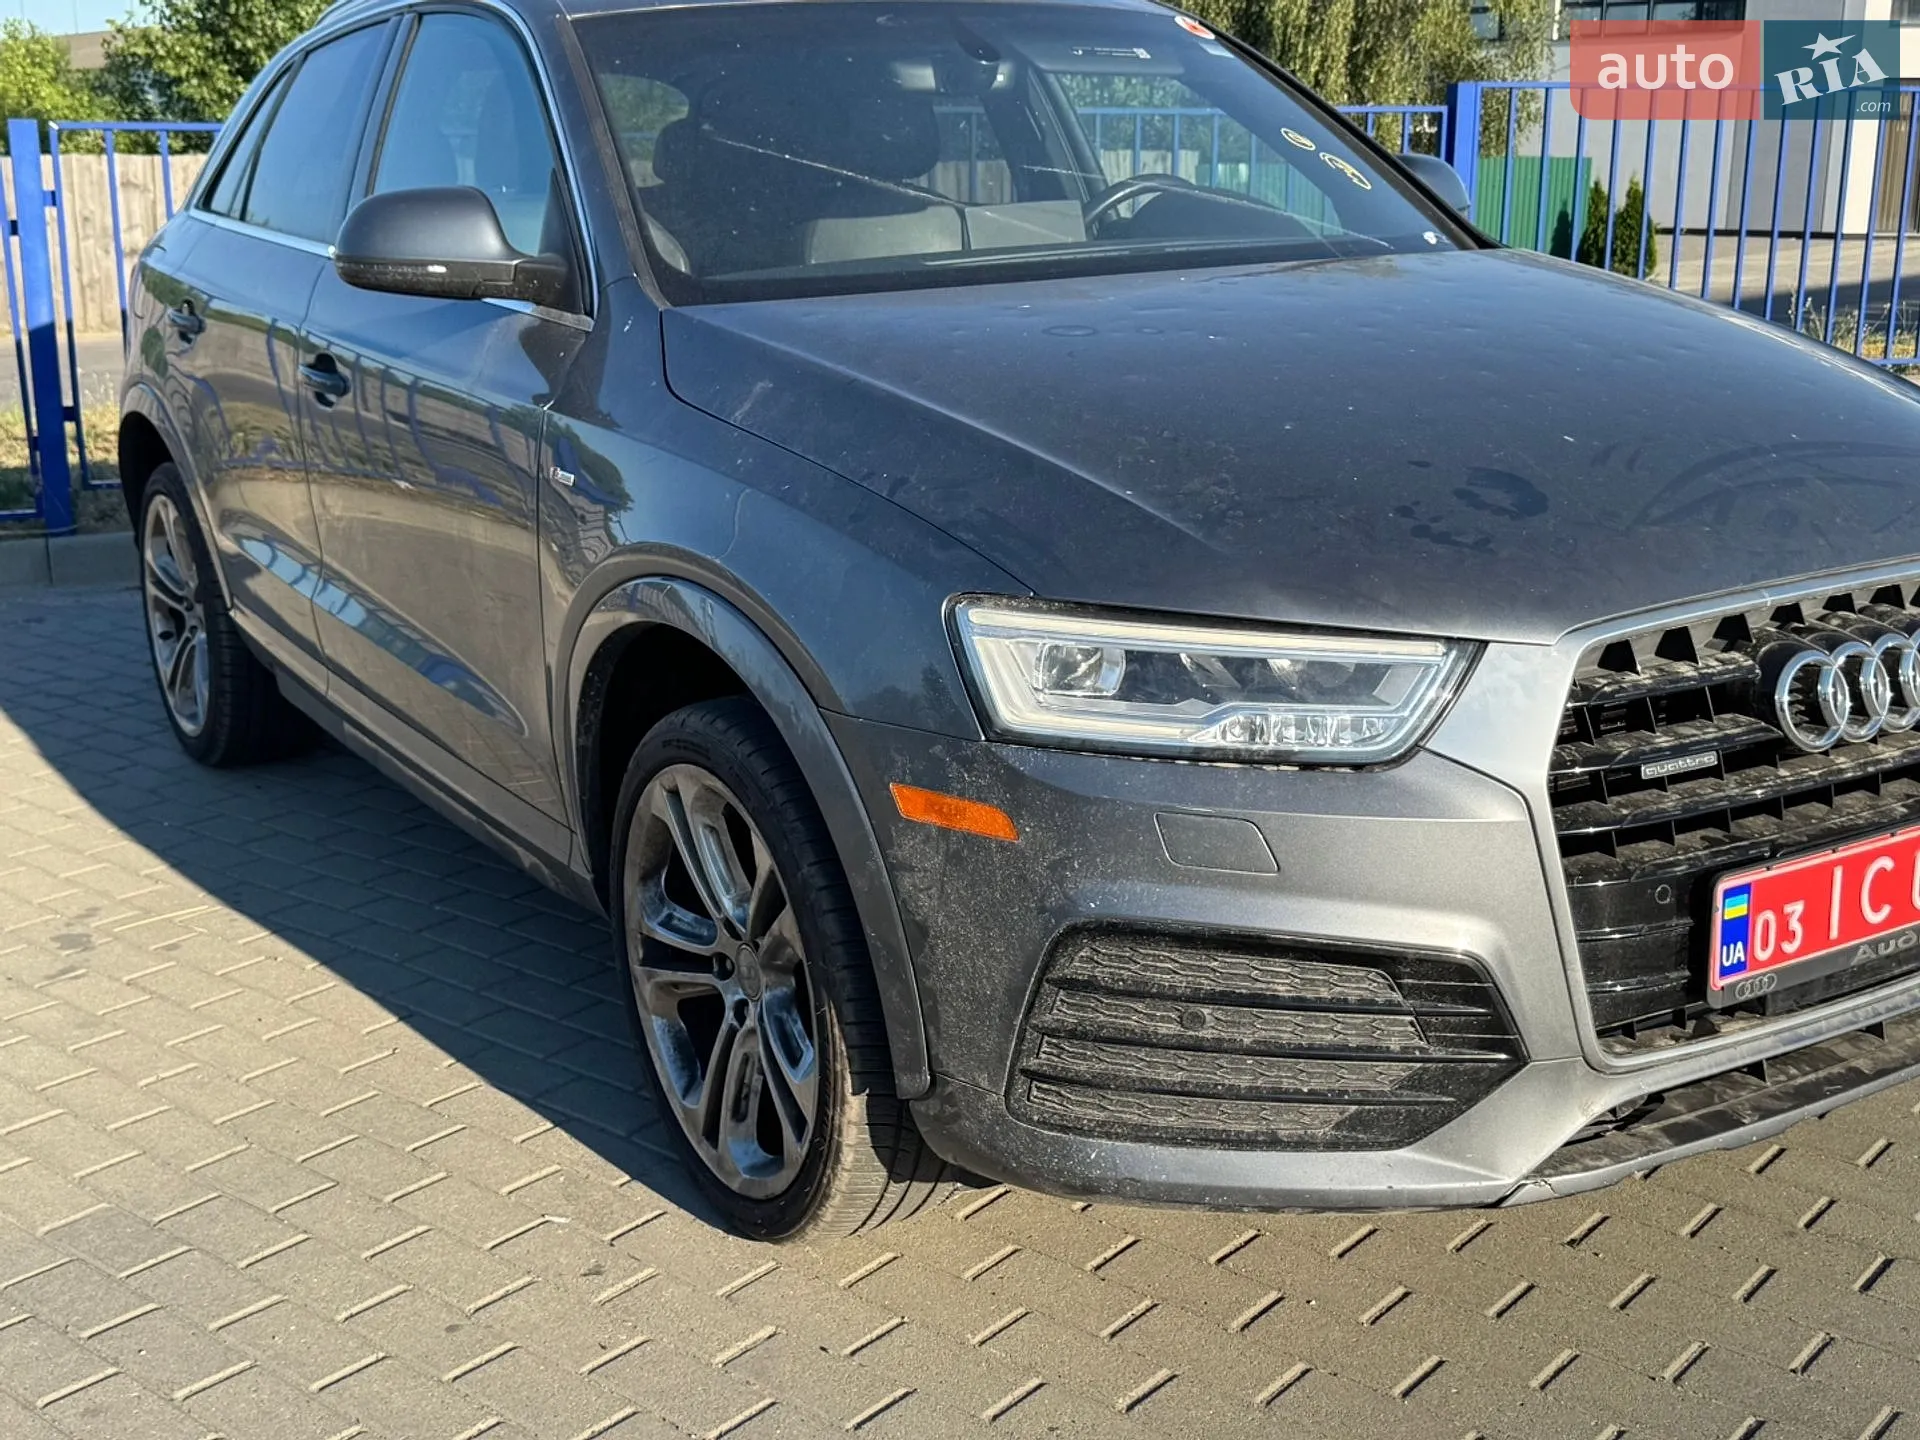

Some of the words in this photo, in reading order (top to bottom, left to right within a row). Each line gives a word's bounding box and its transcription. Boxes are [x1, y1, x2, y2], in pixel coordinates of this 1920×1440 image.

[1644, 754, 1716, 777] quattro
[1753, 900, 1805, 962] 03
[1829, 847, 1920, 941] IC
[1722, 941, 1745, 967] UA
[1851, 930, 1920, 966] Aud
